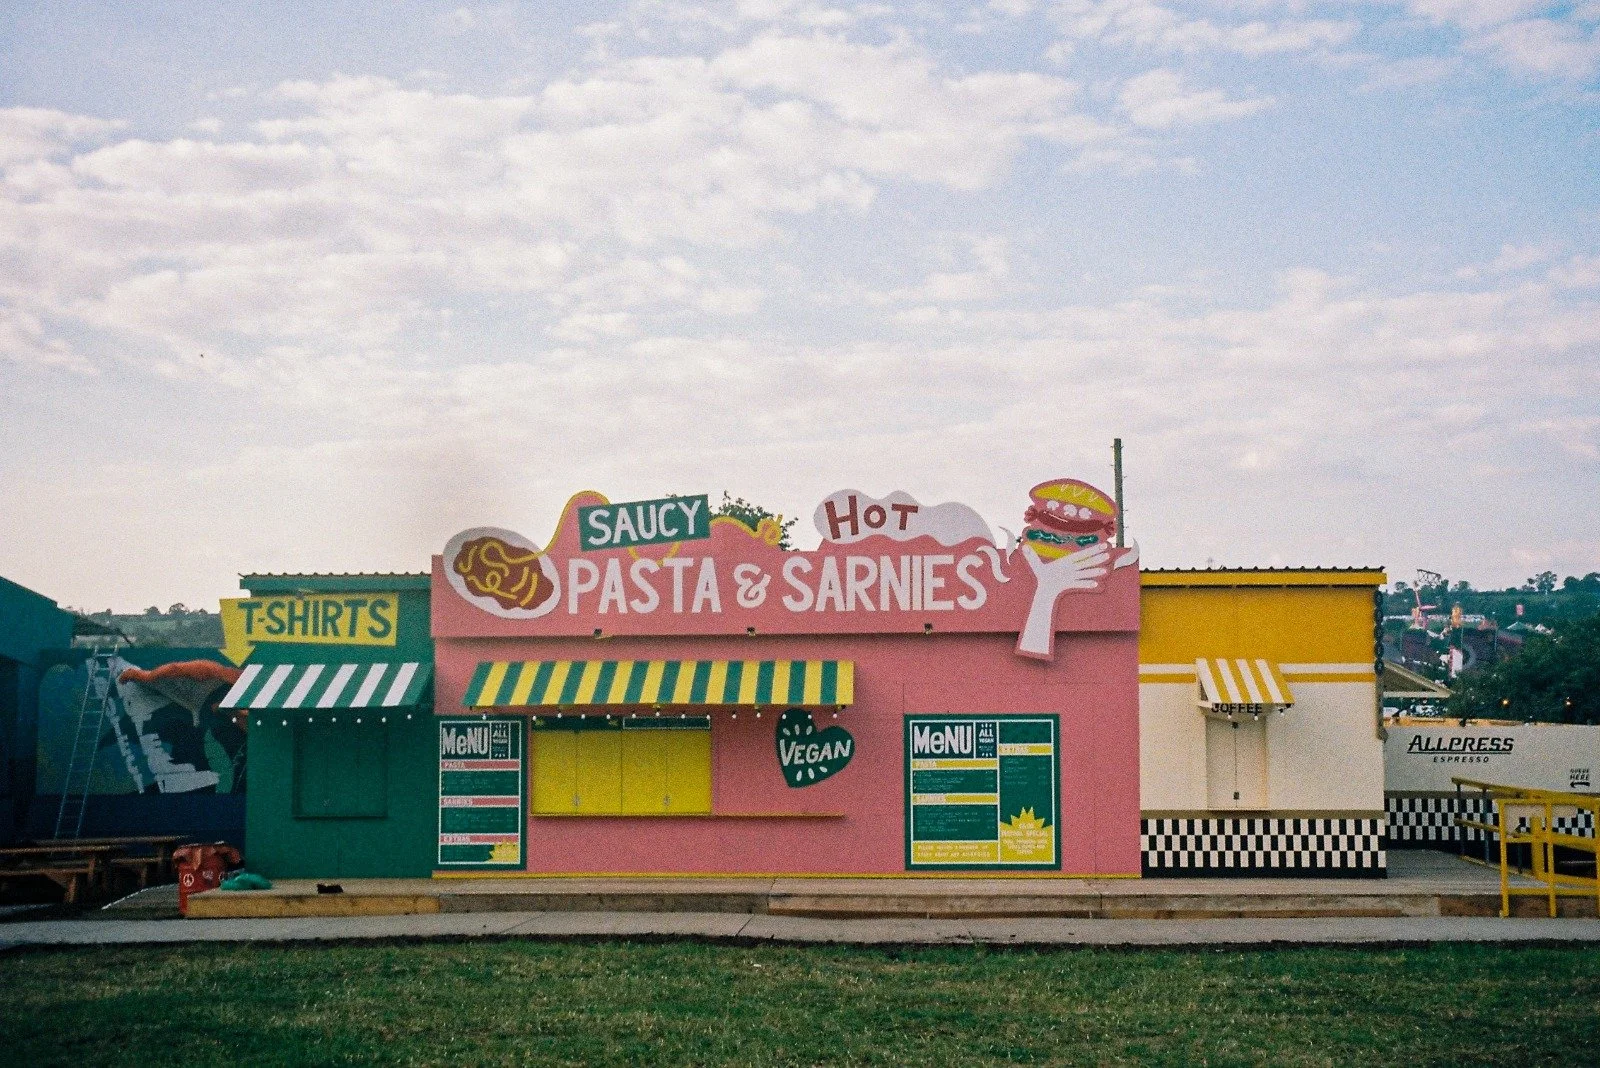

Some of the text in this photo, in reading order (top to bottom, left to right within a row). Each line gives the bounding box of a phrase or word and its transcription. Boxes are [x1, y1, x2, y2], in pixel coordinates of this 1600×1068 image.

[588, 499, 702, 546] SAUCY
[824, 495, 919, 540] HOT
[568, 554, 988, 615] PASTA & SARNIES
[238, 599, 392, 639] T-SHIRTS
[493, 729, 507, 738] ALL
[979, 728, 994, 737] ALL
[1408, 735, 1514, 752] ALLPRESS
[779, 739, 851, 767] VEGAN
